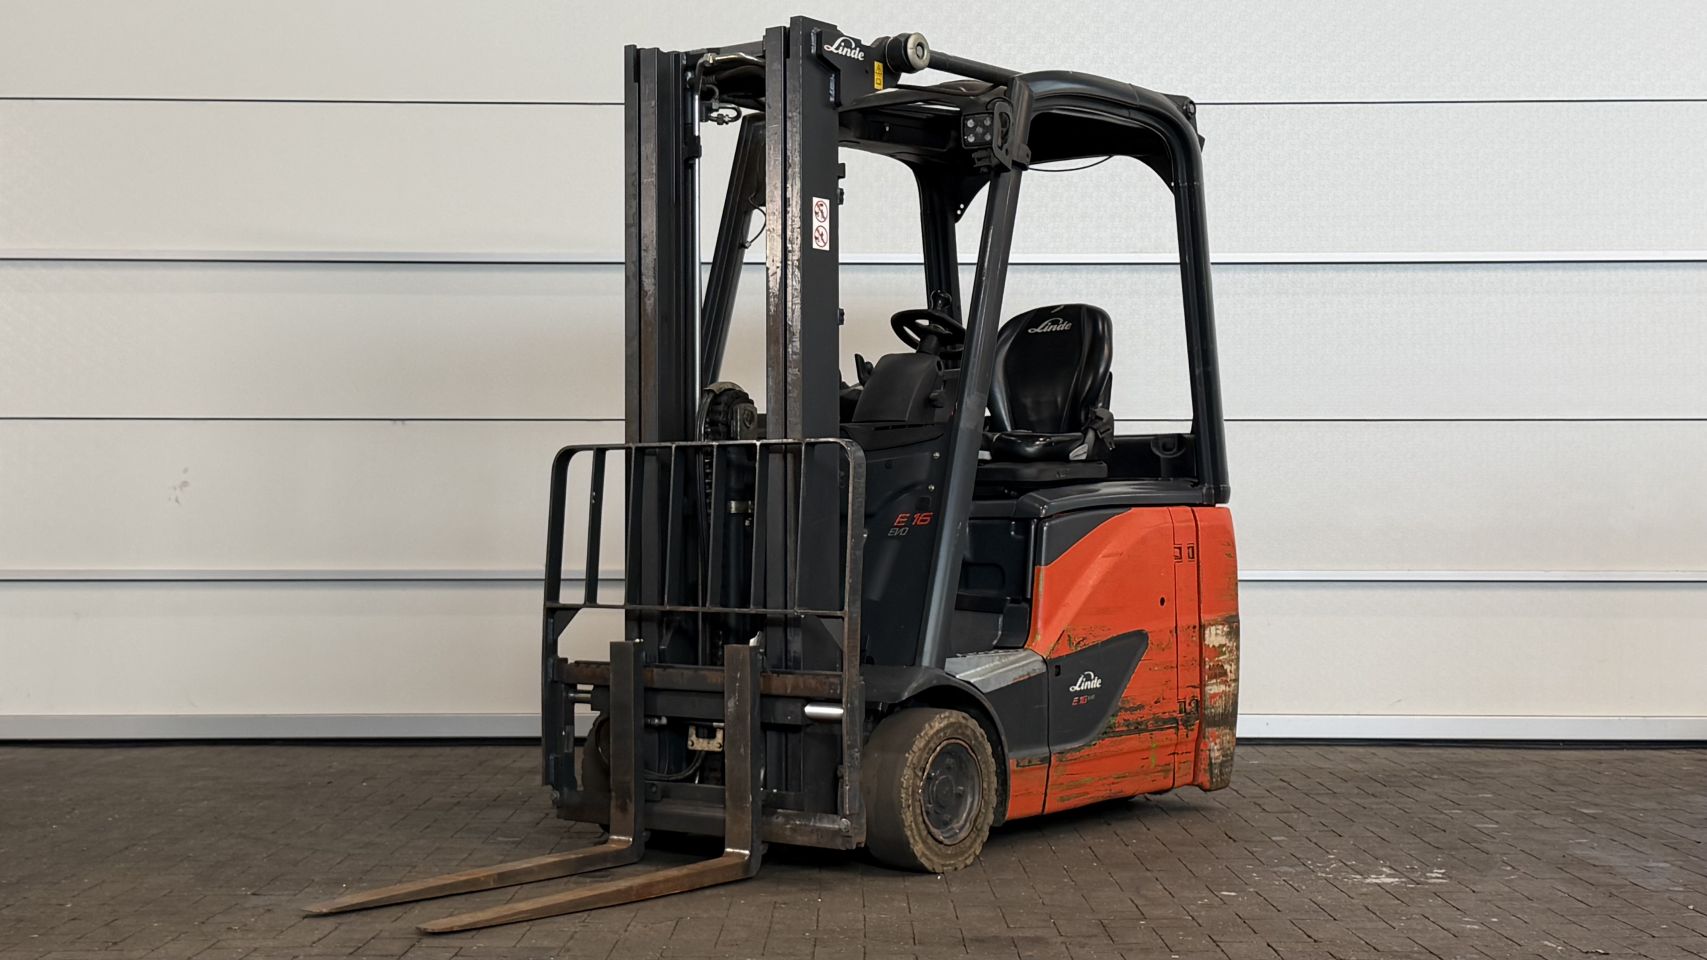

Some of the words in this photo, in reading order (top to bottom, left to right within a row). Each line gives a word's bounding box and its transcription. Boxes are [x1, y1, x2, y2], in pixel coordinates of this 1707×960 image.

[823, 36, 865, 61] Linde
[1027, 317, 1073, 334] Linde
[894, 513, 911, 526] E
[912, 512, 934, 526] 16
[888, 527, 909, 537] EVO
[1069, 671, 1102, 692] Linde
